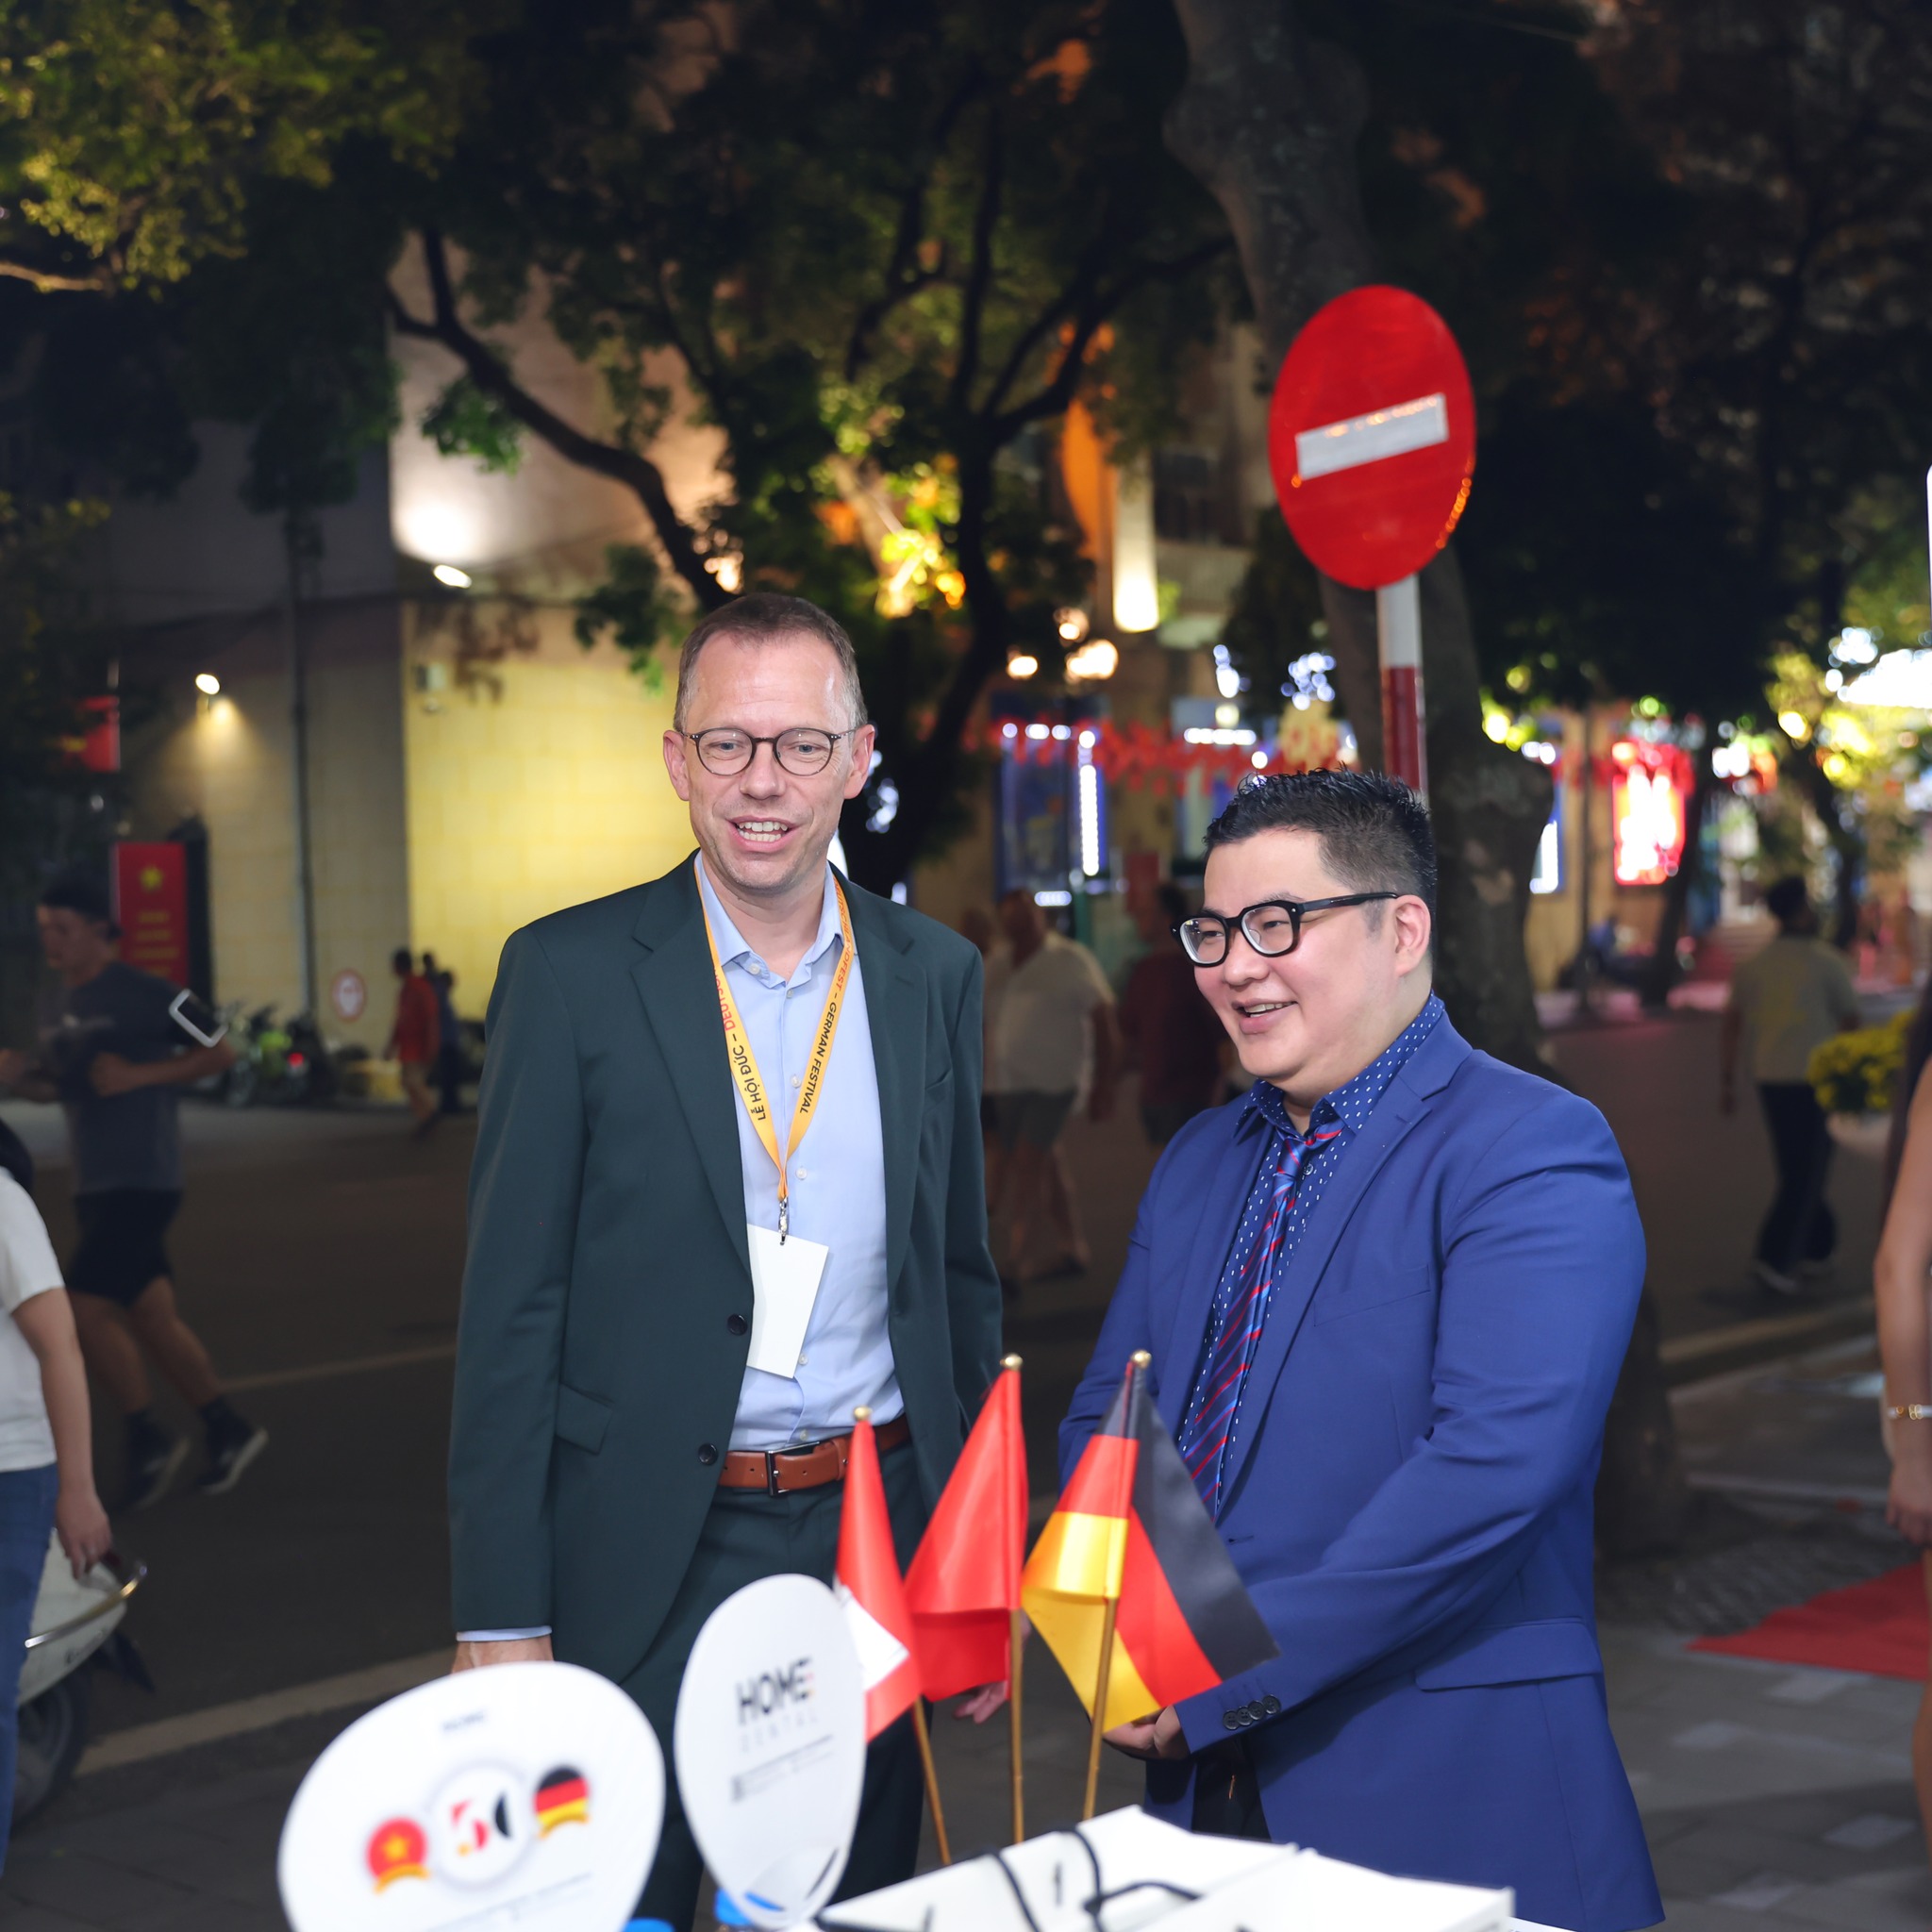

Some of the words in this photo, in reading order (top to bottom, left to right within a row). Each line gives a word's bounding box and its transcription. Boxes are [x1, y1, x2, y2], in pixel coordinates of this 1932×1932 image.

[816, 1002, 837, 1058] GERMAN
[733, 1044, 752, 1074] ĐỨC
[744, 1077, 761, 1103] HỘI
[799, 1058, 822, 1113] FESTIVAL
[750, 1105, 766, 1121] LỄ
[736, 1657, 814, 1725] HOME
